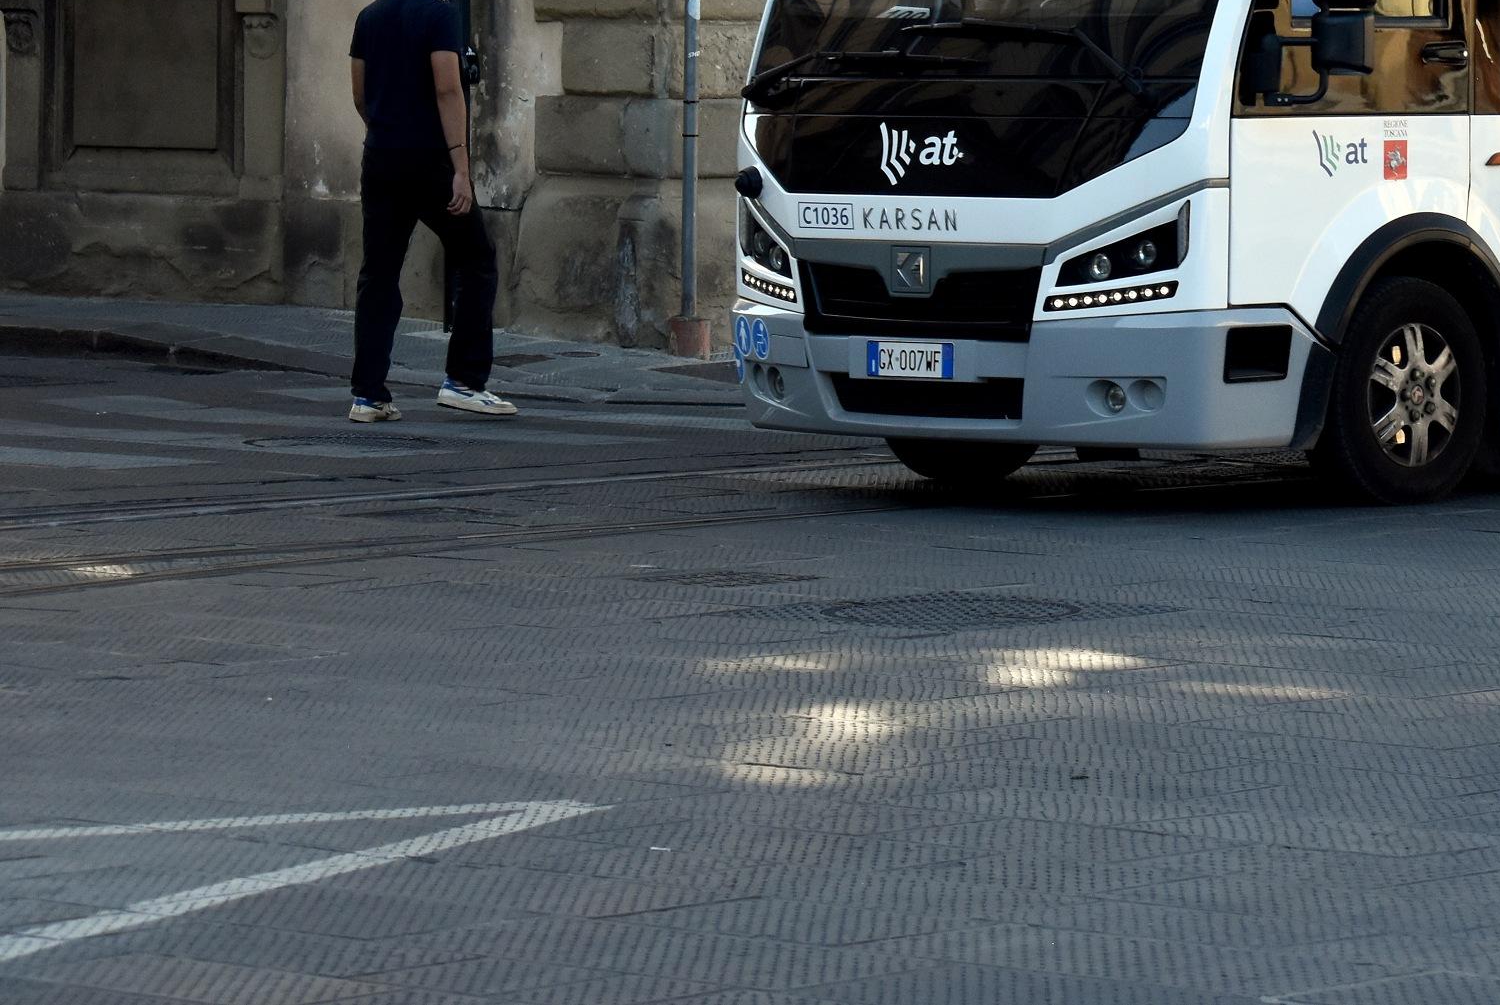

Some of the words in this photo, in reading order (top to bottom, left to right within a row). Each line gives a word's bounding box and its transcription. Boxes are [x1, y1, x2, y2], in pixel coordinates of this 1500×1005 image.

[1384, 119, 1408, 128] REGIONE
[1384, 129, 1408, 137] TOSCANA
[919, 130, 958, 166] at
[1345, 137, 1368, 164] at
[802, 206, 849, 226] C1036
[863, 207, 958, 232] KARSAN
[879, 348, 894, 370] GX
[899, 349, 941, 372] 007WF
